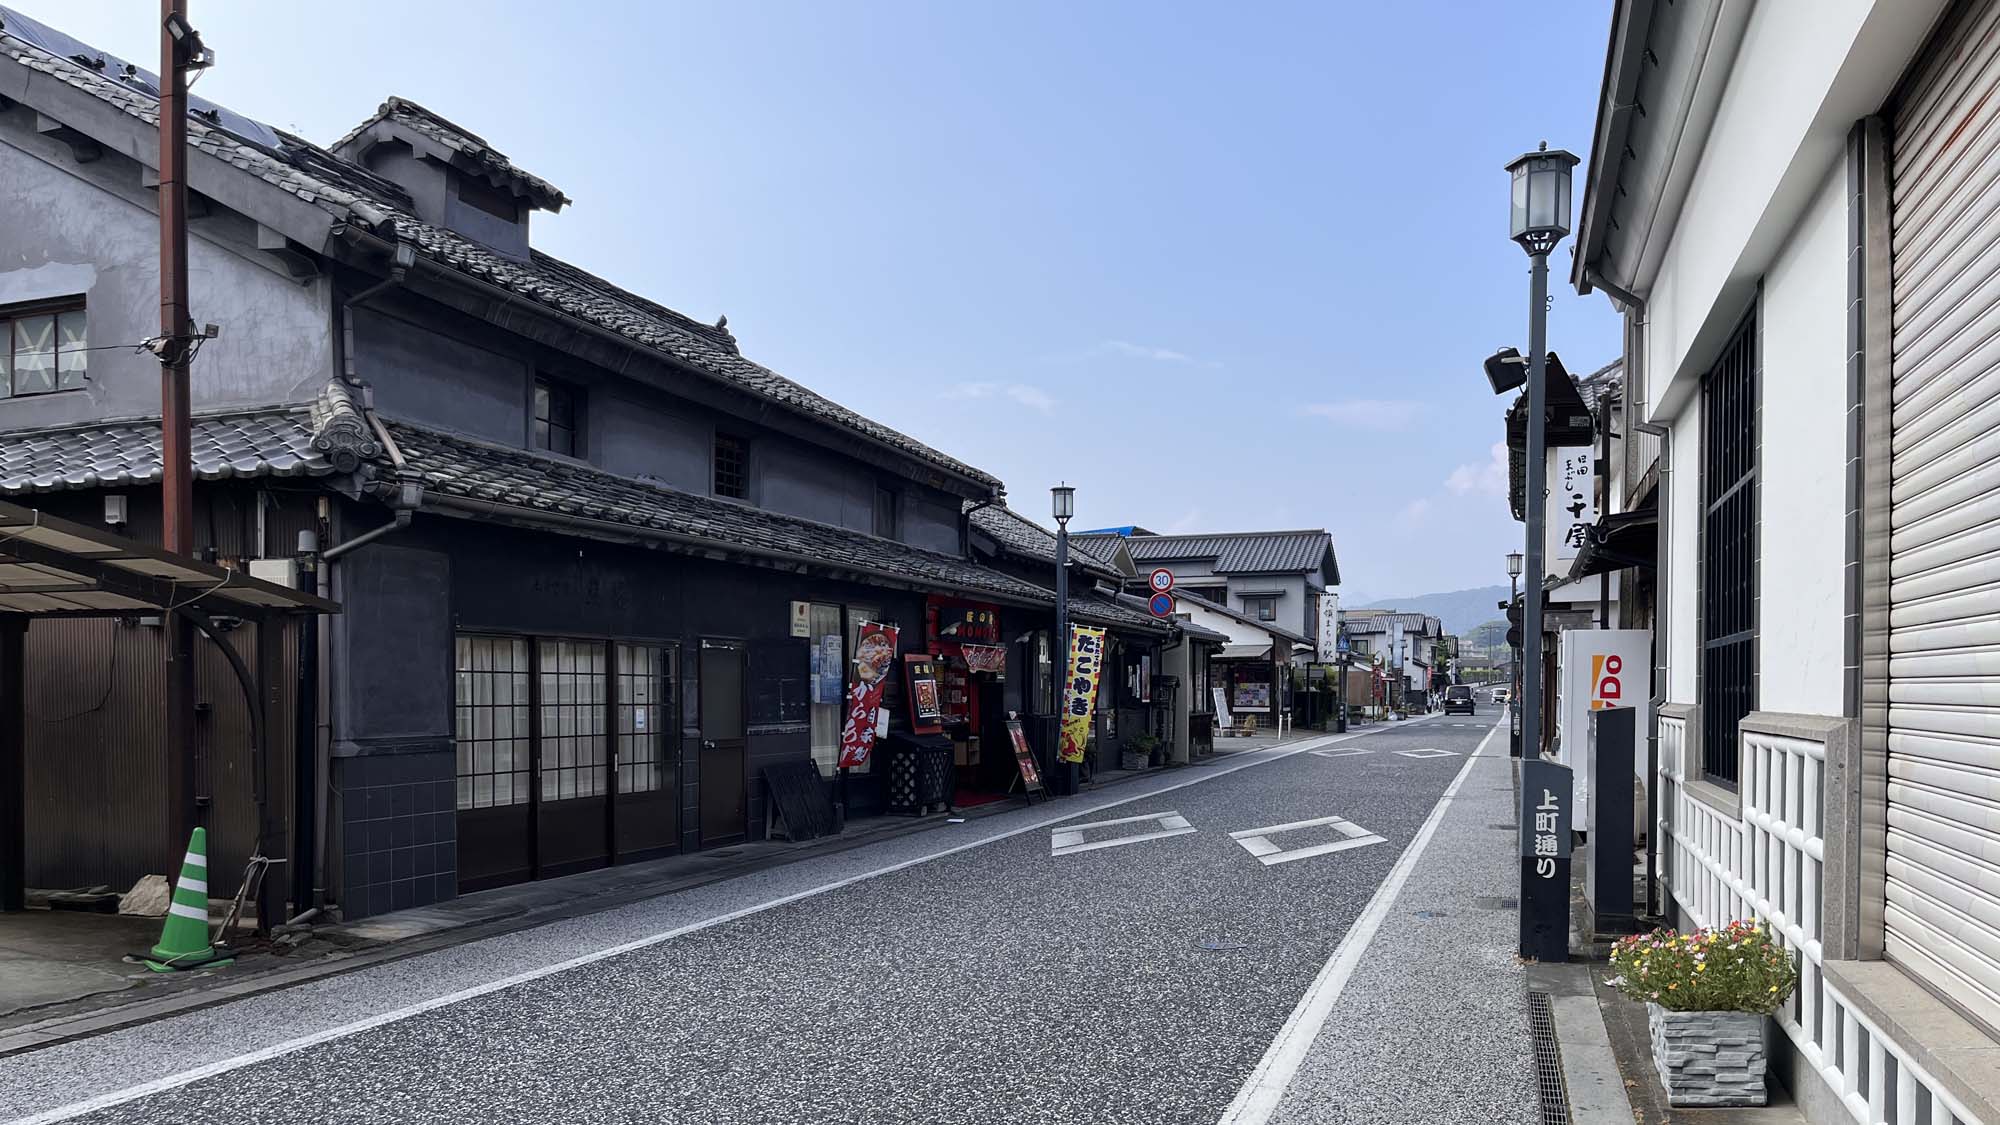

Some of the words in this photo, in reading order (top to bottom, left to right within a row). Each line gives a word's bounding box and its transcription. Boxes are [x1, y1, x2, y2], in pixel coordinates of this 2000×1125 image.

[1577, 454, 1588, 475] 日田
[1565, 493, 1587, 549] 千屋
[1155, 575, 1169, 586] 30
[1324, 599, 1333, 659] 天領まちの駅
[1071, 634, 1095, 716] たこやき
[842, 680, 874, 761] からあげ
[852, 706, 877, 762] 自家製
[1535, 788, 1559, 879] 上町通り
